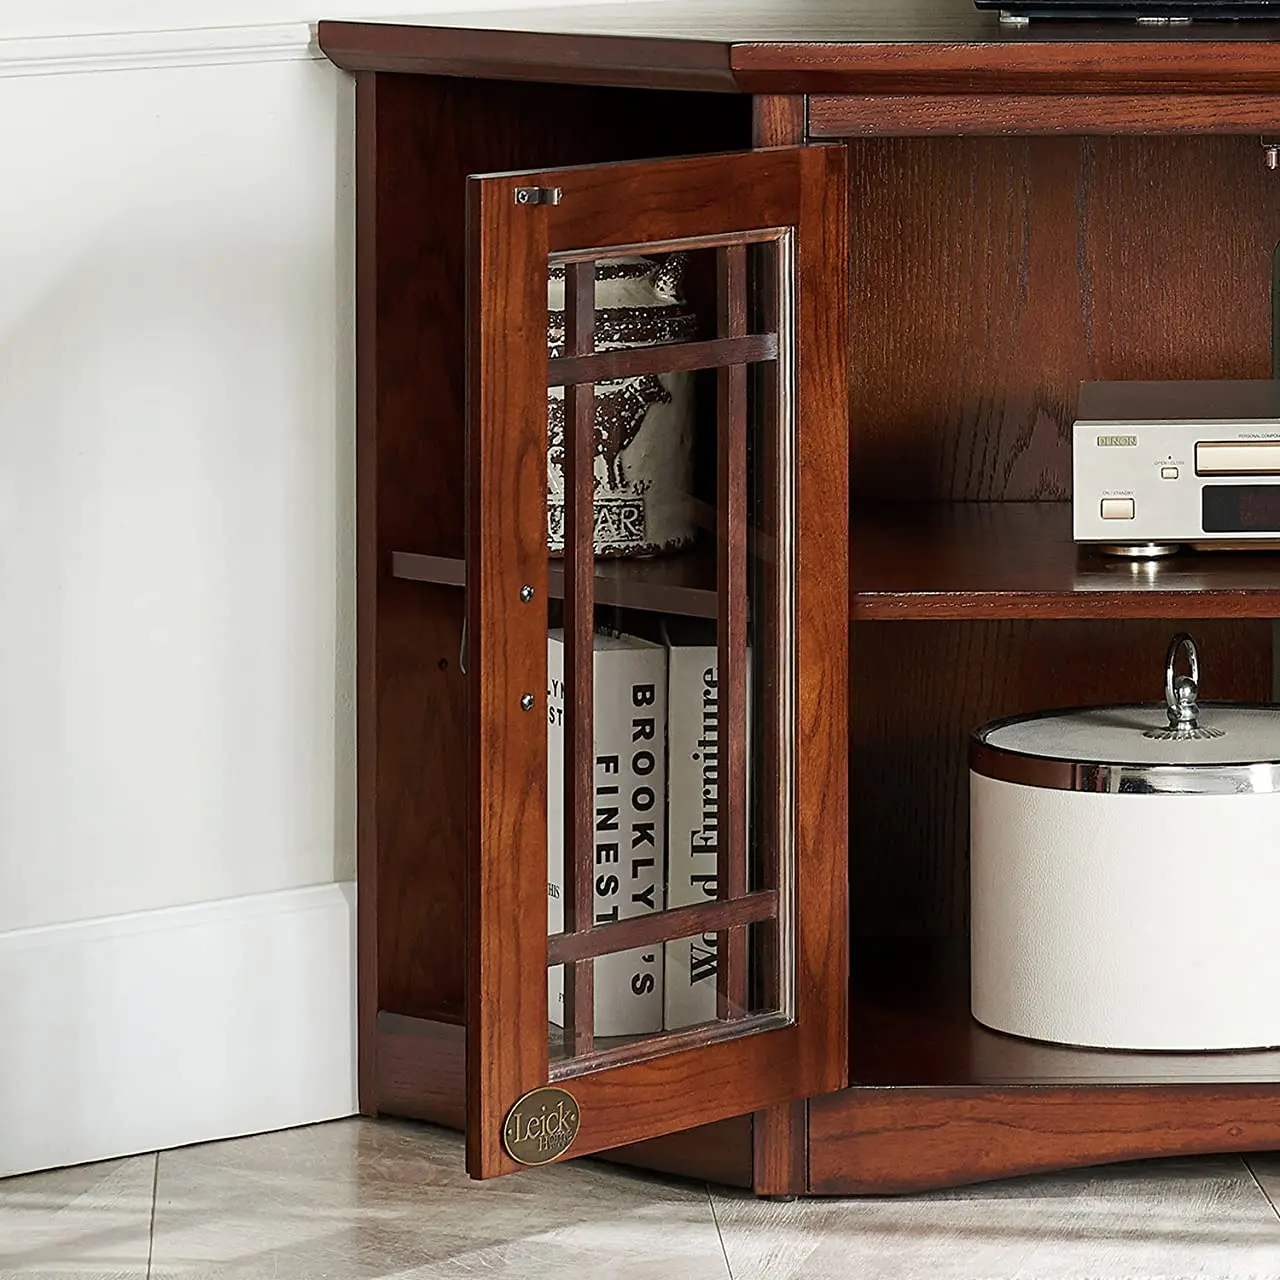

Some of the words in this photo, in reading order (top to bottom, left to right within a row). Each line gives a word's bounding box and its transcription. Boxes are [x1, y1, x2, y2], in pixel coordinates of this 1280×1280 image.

[690, 667, 719, 858] Furniture
[631, 683, 655, 996] BROOKLY'S
[513, 1100, 572, 1144] Leick
[538, 1128, 573, 1152] Home
